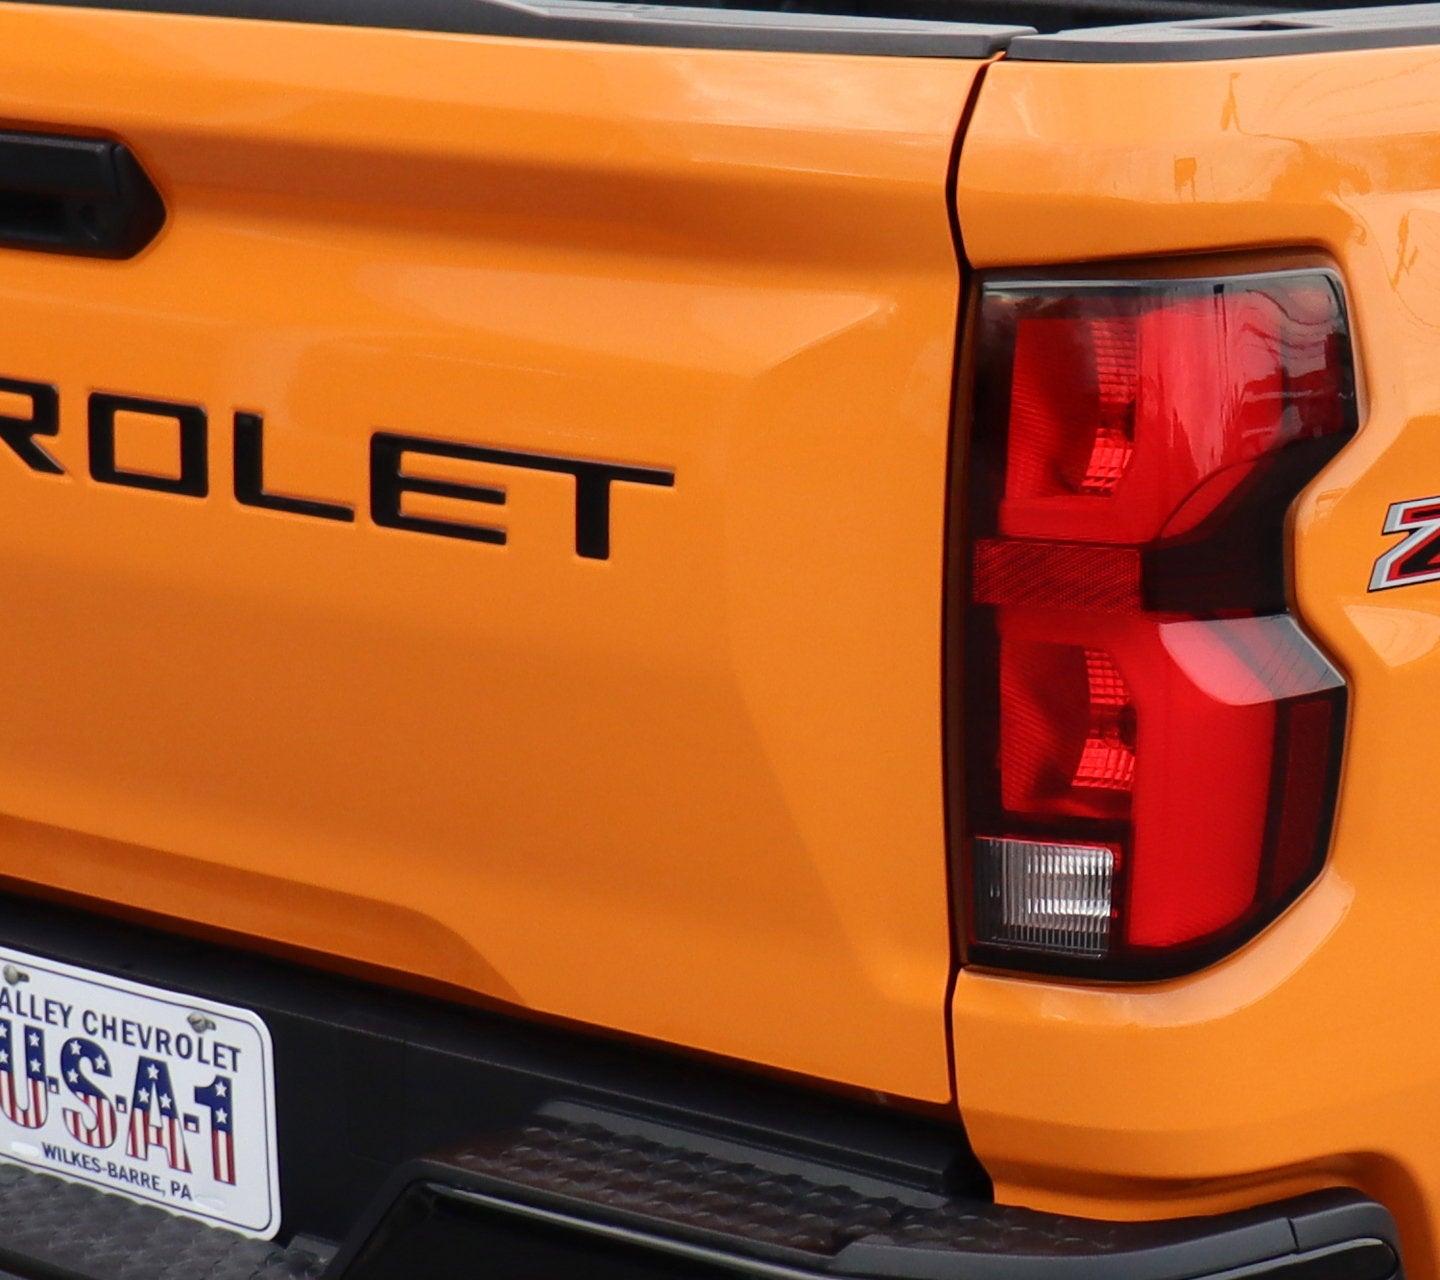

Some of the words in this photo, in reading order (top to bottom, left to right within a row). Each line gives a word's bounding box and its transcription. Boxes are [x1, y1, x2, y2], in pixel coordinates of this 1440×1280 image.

[82, 1009, 242, 1072] CHEVROLET
[42, 1142, 166, 1197] WILKES-BARRE,
[171, 1180, 193, 1201] PA
